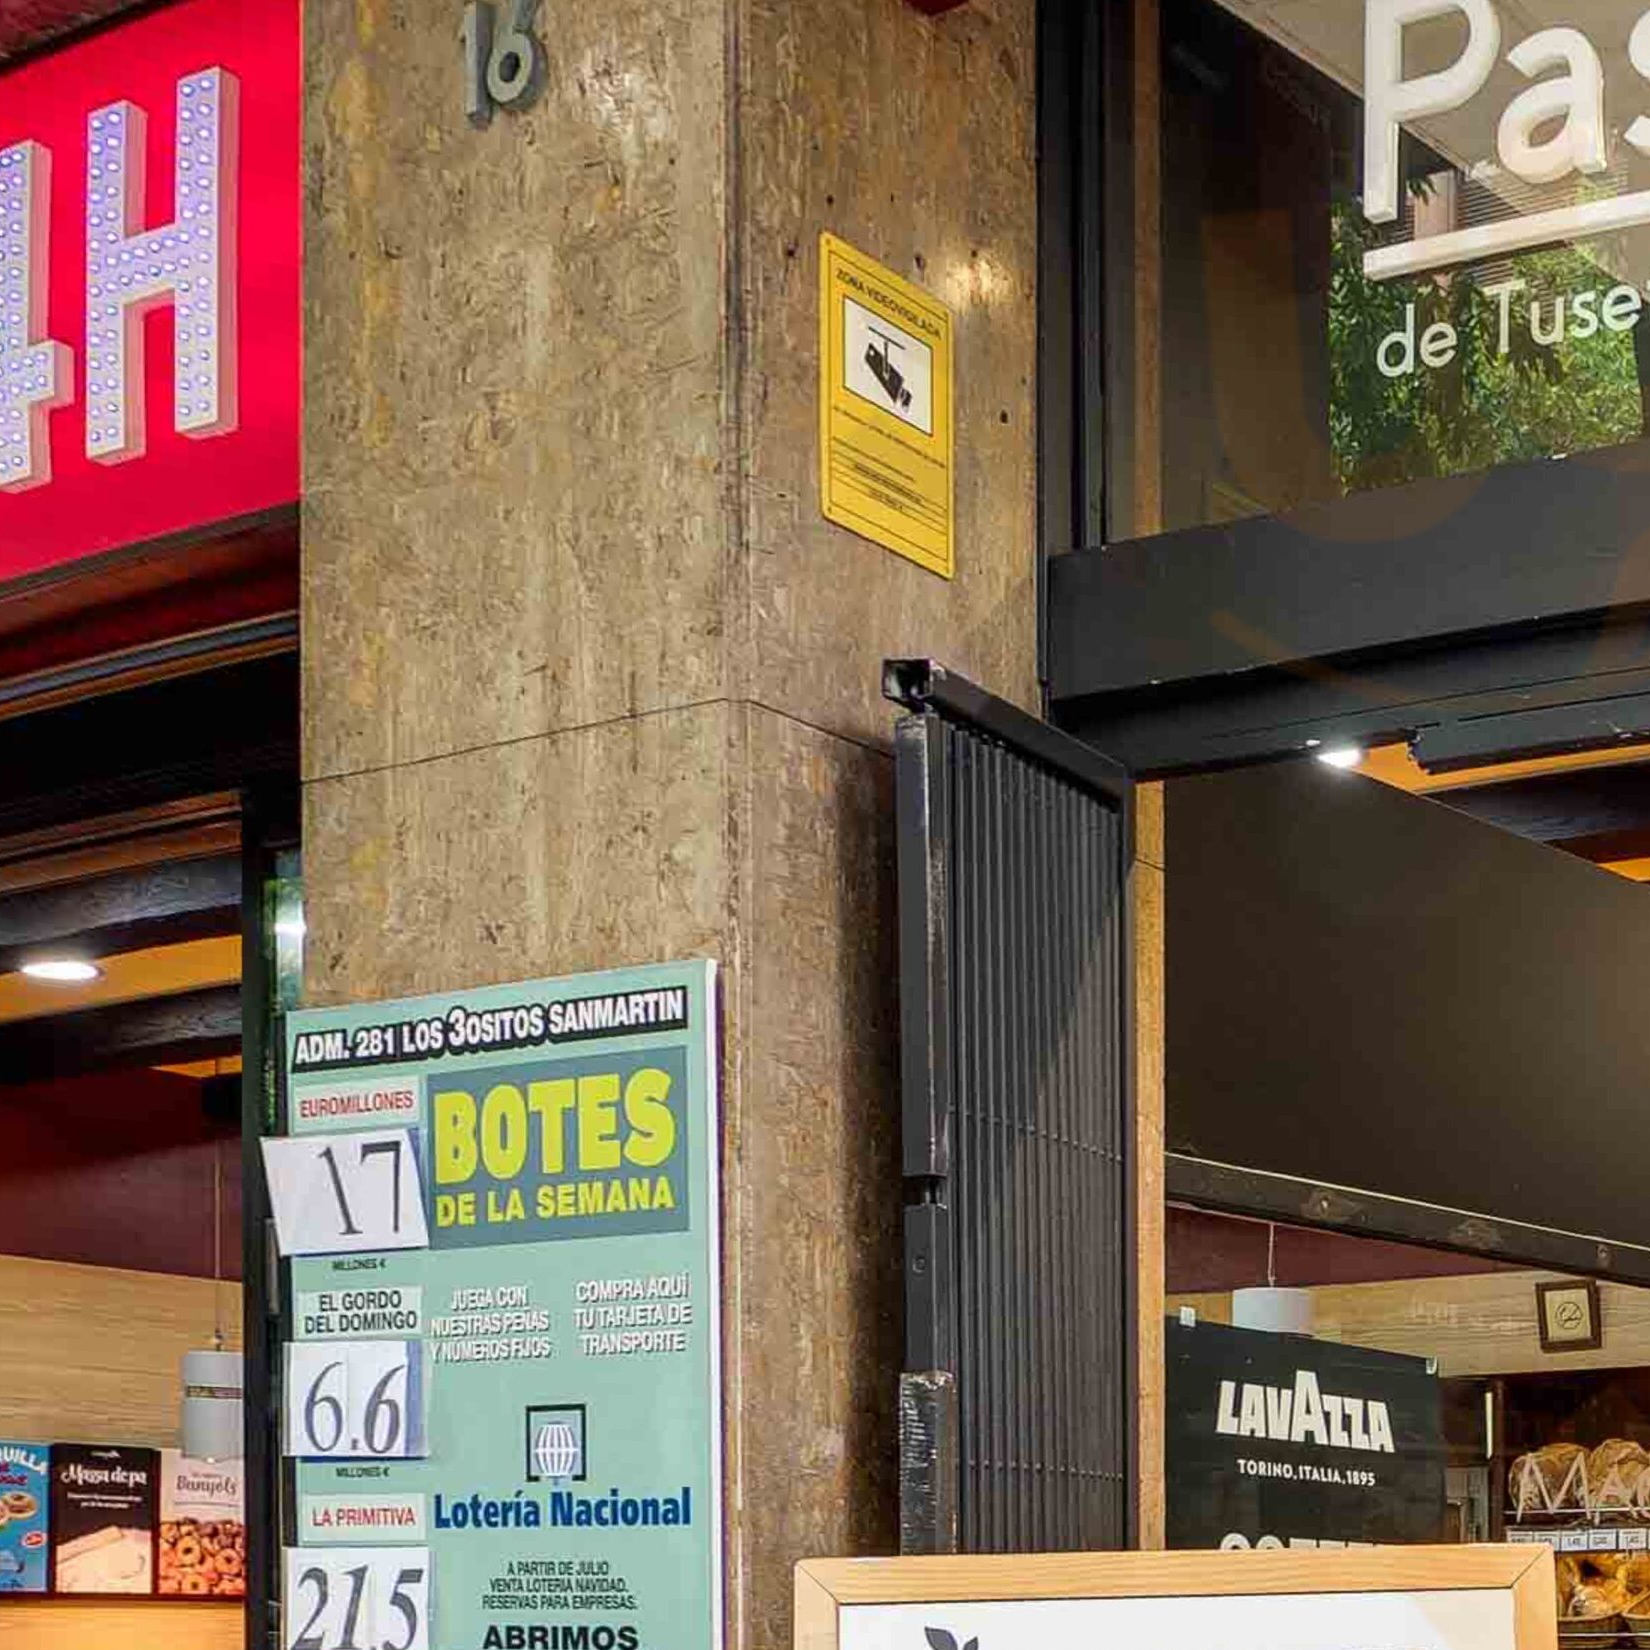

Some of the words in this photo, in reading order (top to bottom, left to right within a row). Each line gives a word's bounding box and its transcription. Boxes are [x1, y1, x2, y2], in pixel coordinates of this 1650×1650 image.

[464, 0, 550, 130] 16
[1375, 303, 1458, 378] de
[296, 1032, 351, 1065] ADM.
[356, 1028, 394, 1057] 281
[401, 1020, 443, 1053] LOS
[549, 987, 685, 1034] SANMARTIN
[300, 1091, 414, 1120] EUROMILLONES
[433, 1067, 678, 1186] BOTES
[318, 1139, 402, 1235] 17
[436, 1193, 477, 1228] DE
[487, 1189, 526, 1225] LA
[537, 1176, 677, 1220] SEMANA
[319, 1294, 342, 1312] EL
[343, 1290, 403, 1312] GORDO
[451, 1289, 494, 1311] JUEGA
[497, 1285, 529, 1309] CON
[576, 1278, 644, 1302] COMPRA
[304, 1315, 337, 1335] DEL
[339, 1310, 418, 1333] DOMINGO
[431, 1316, 501, 1338] NUESTRAS
[574, 1307, 597, 1328] TU
[599, 1304, 665, 1327] TARJETA
[667, 1302, 693, 1325] DE
[431, 1344, 442, 1362] Y
[511, 1336, 552, 1359] FIJOS
[583, 1332, 686, 1355] TRANSPORTE
[1215, 1369, 1396, 1453] LAVAZZA
[312, 1509, 334, 1527] LA
[336, 1507, 417, 1527] PRIMITIVA
[434, 1490, 540, 1529] Lotería
[551, 1486, 692, 1527] Nacional
[507, 1561, 516, 1576] A
[518, 1561, 556, 1576] PARTIR
[559, 1561, 574, 1576] DE
[576, 1561, 609, 1576] JULIO
[490, 1578, 524, 1593] VENTA
[483, 1595, 537, 1609] RESERVAS
[540, 1595, 569, 1609] PARA
